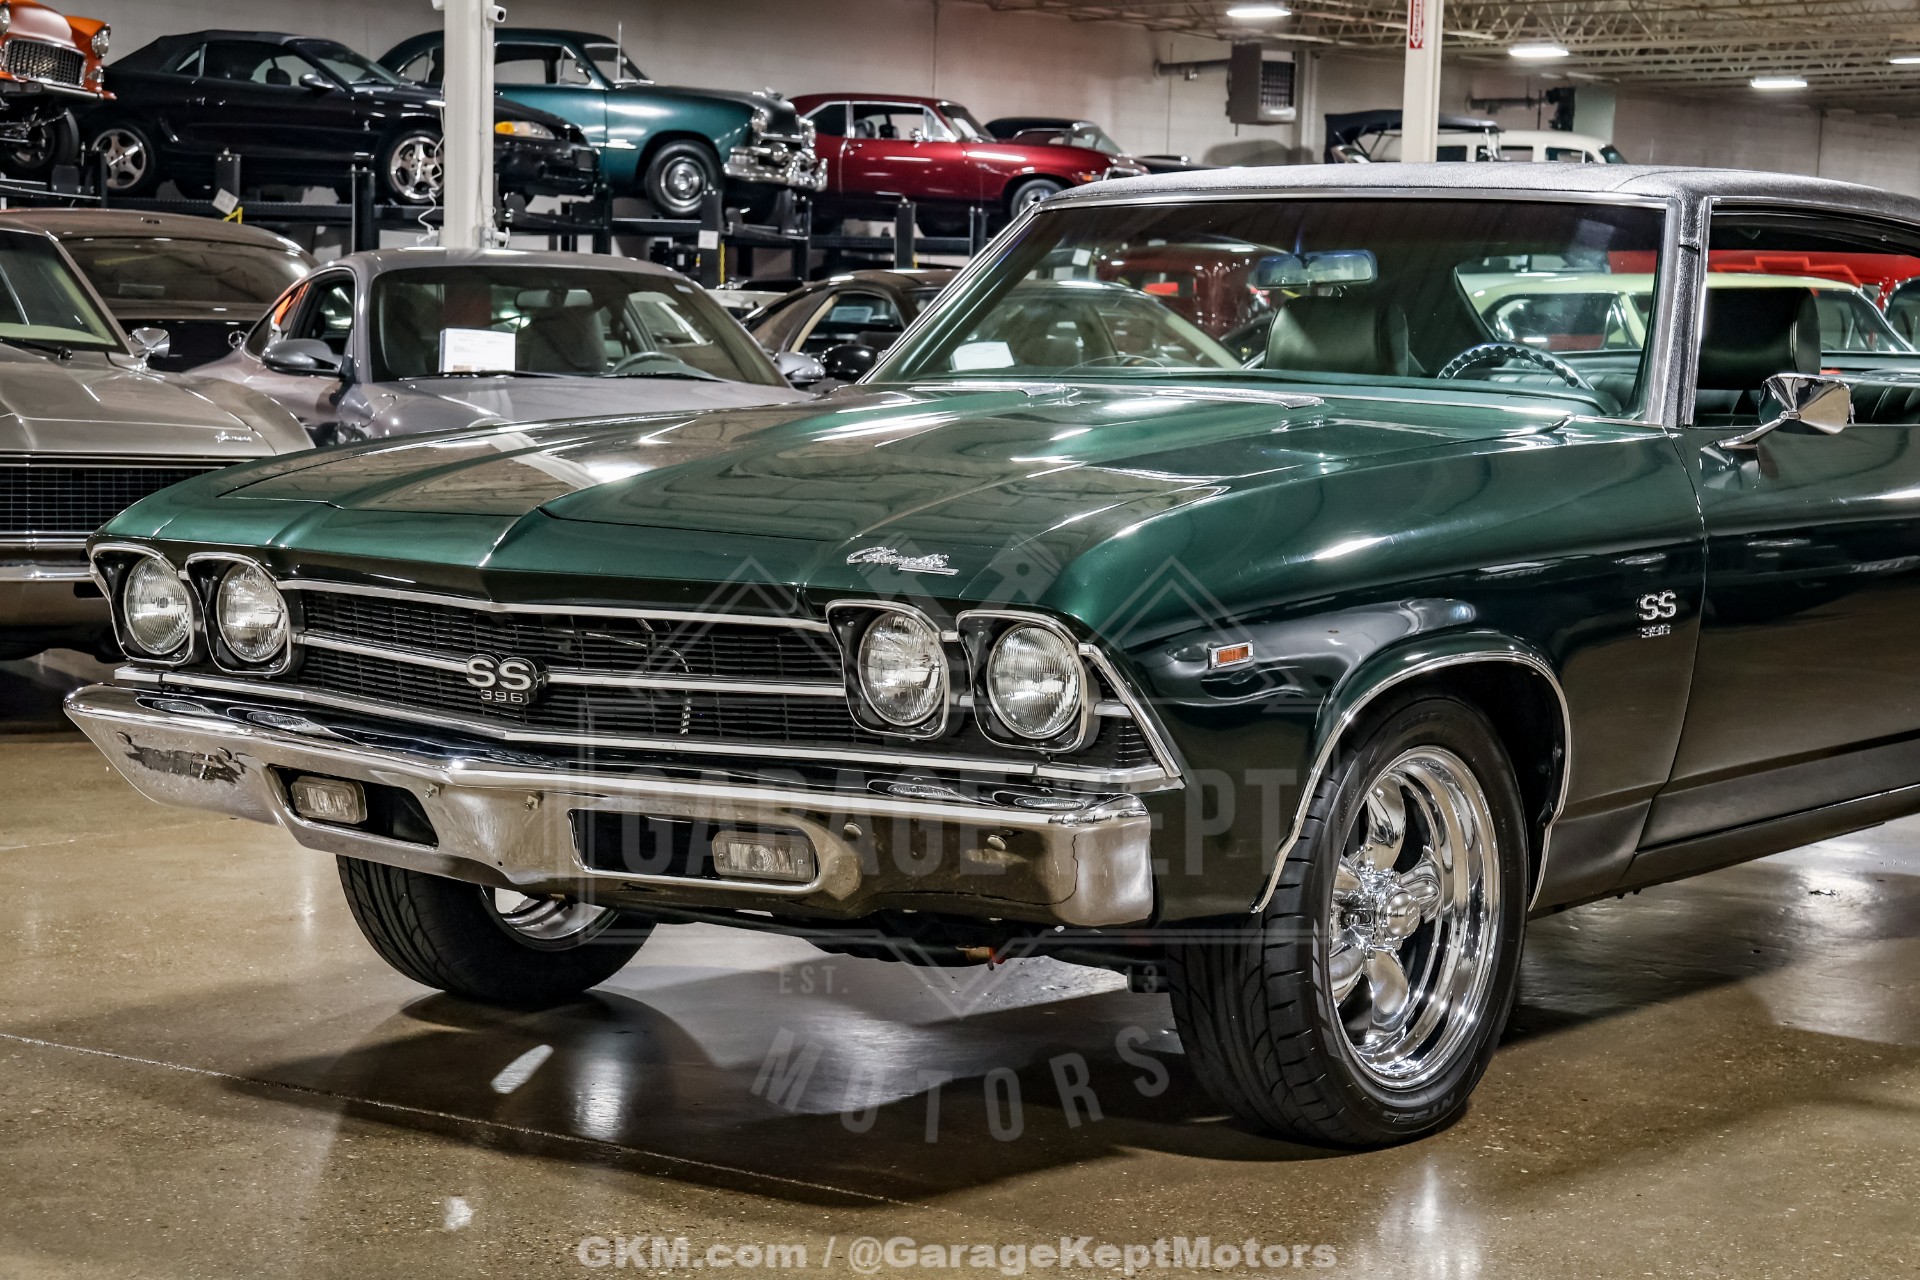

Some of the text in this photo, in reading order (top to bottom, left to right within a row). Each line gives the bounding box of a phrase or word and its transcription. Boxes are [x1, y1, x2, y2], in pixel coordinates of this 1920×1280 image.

[1638, 592, 1677, 620] SS
[466, 658, 532, 691] SS
[480, 689, 524, 703] 396
